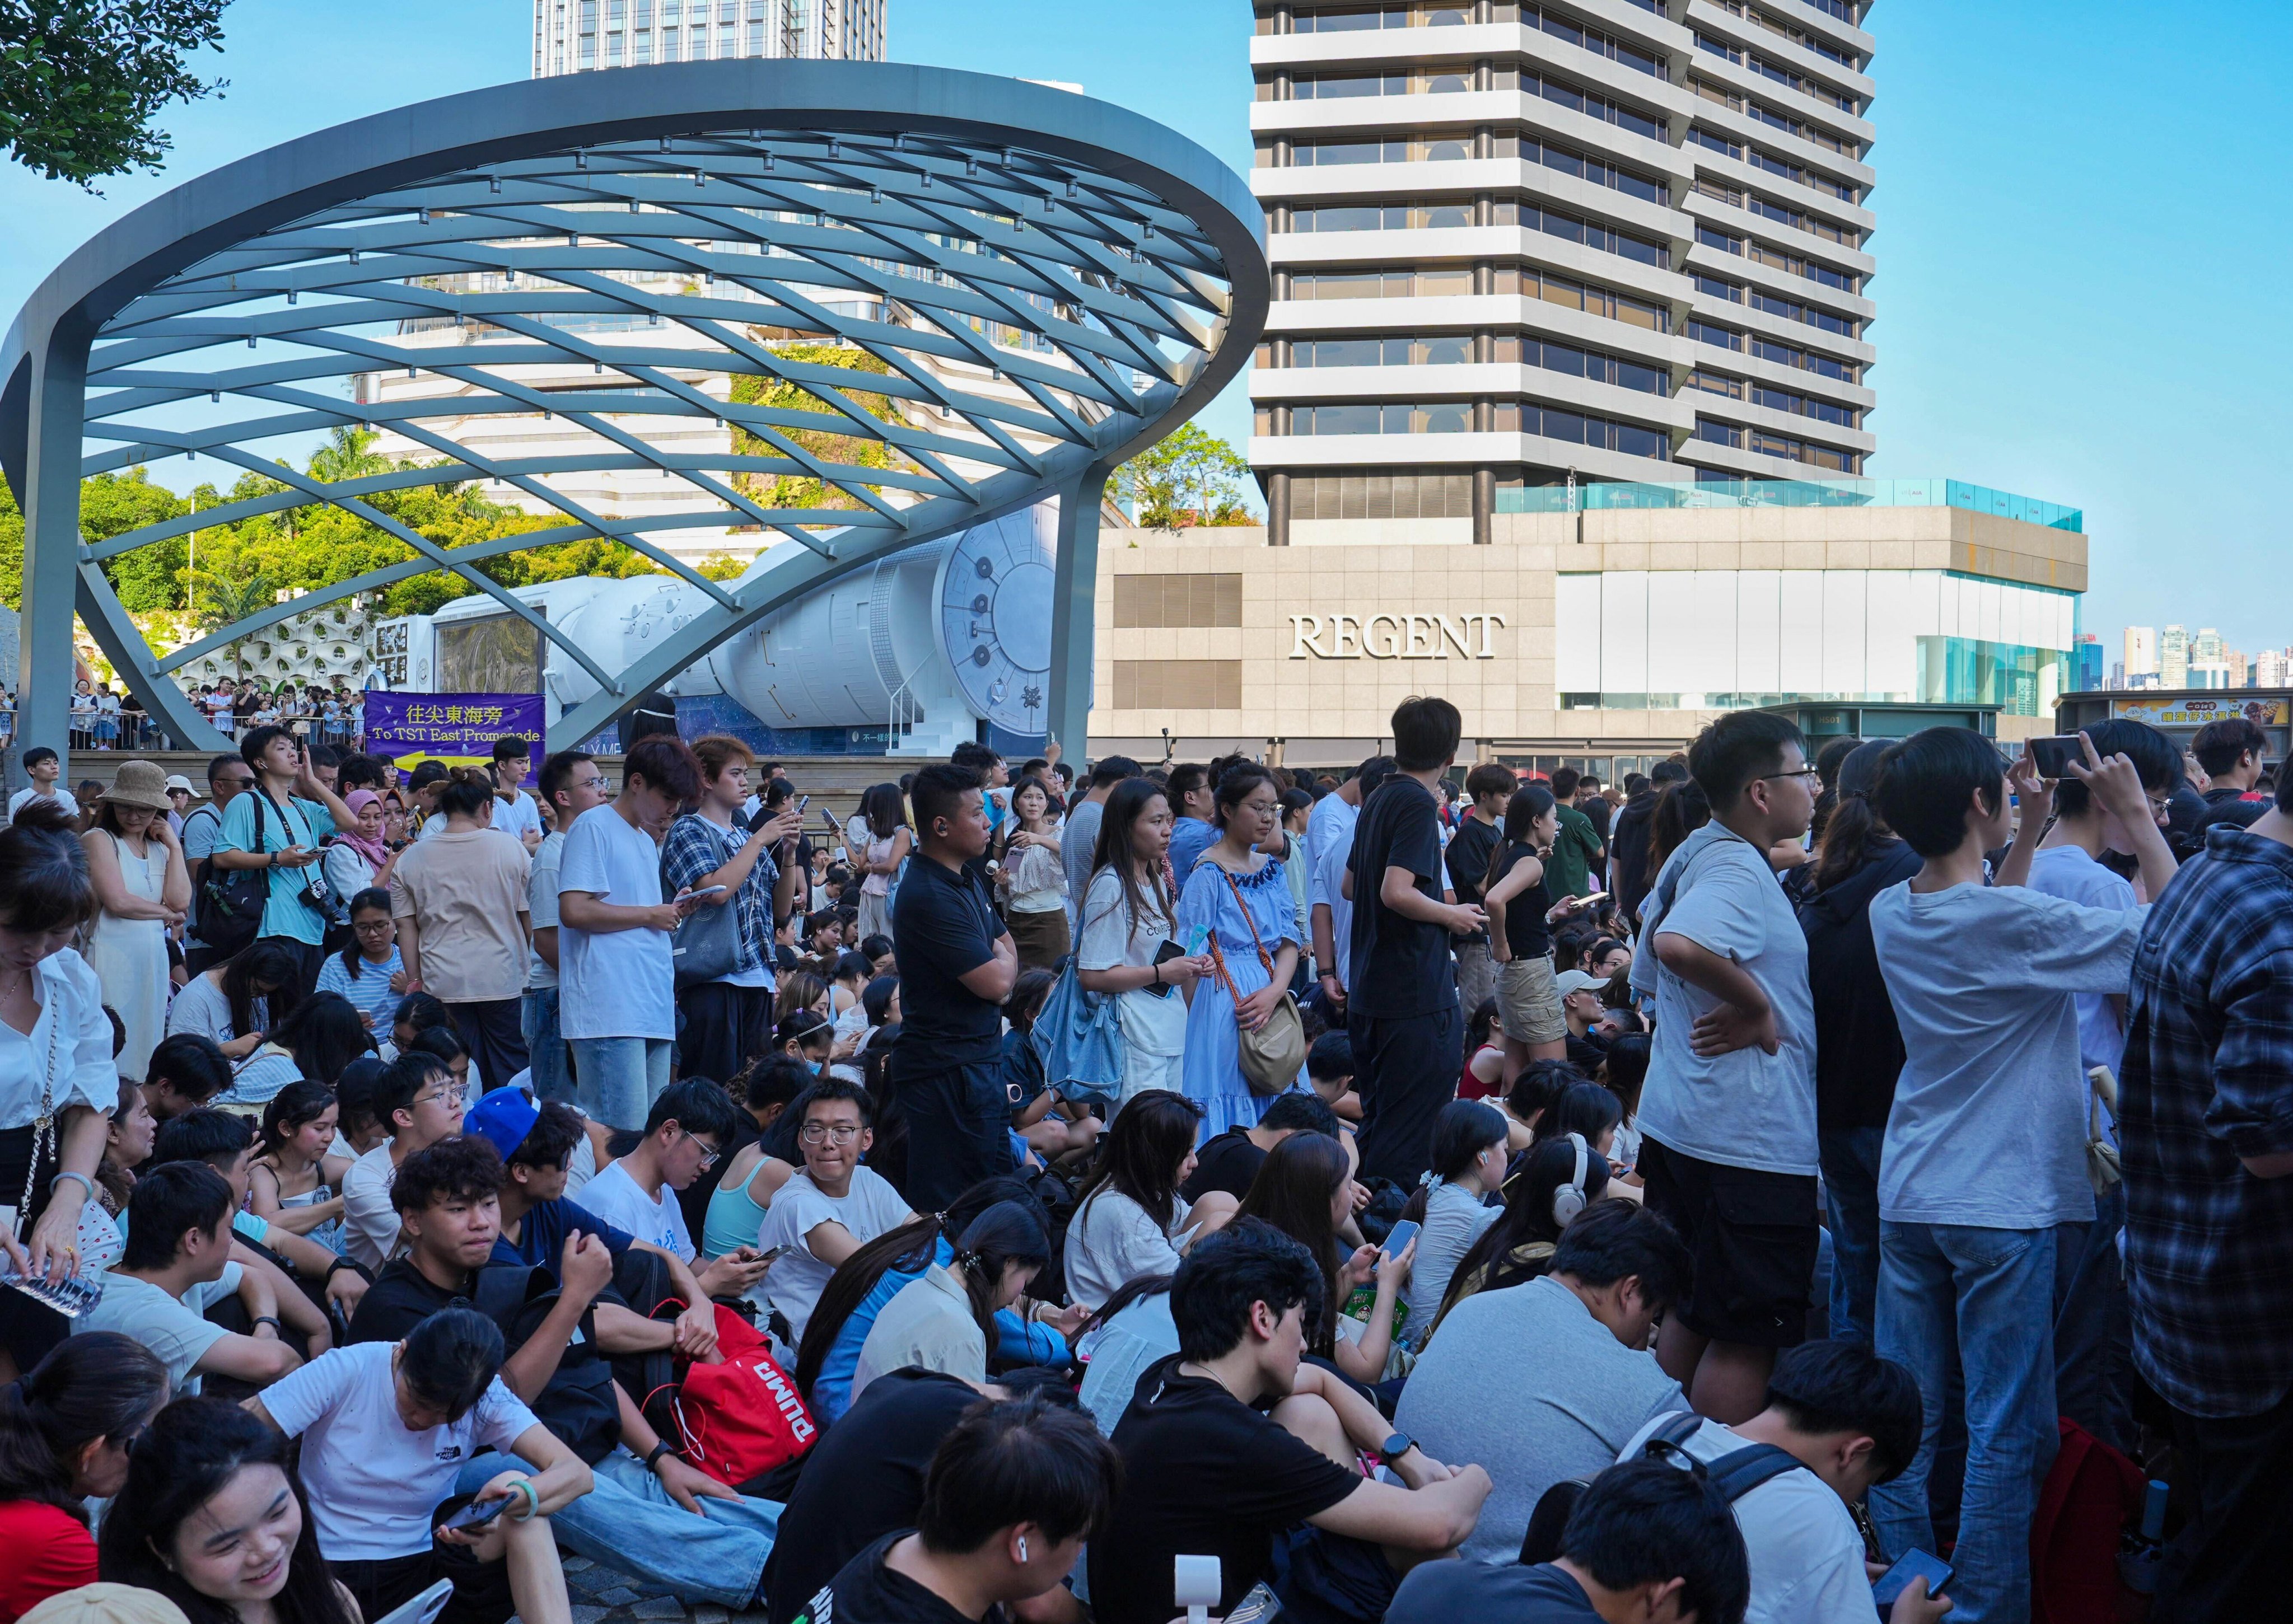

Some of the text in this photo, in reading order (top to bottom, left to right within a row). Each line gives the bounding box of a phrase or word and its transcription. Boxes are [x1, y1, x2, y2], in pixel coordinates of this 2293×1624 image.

[1289, 614, 1506, 659] REGENT
[407, 704, 503, 726] 往尖東海旁
[2162, 712, 2240, 722] 雞蛋仔冰淇淋
[372, 727, 540, 742] To TST East Promenade
[753, 1361, 815, 1443] PUMA
